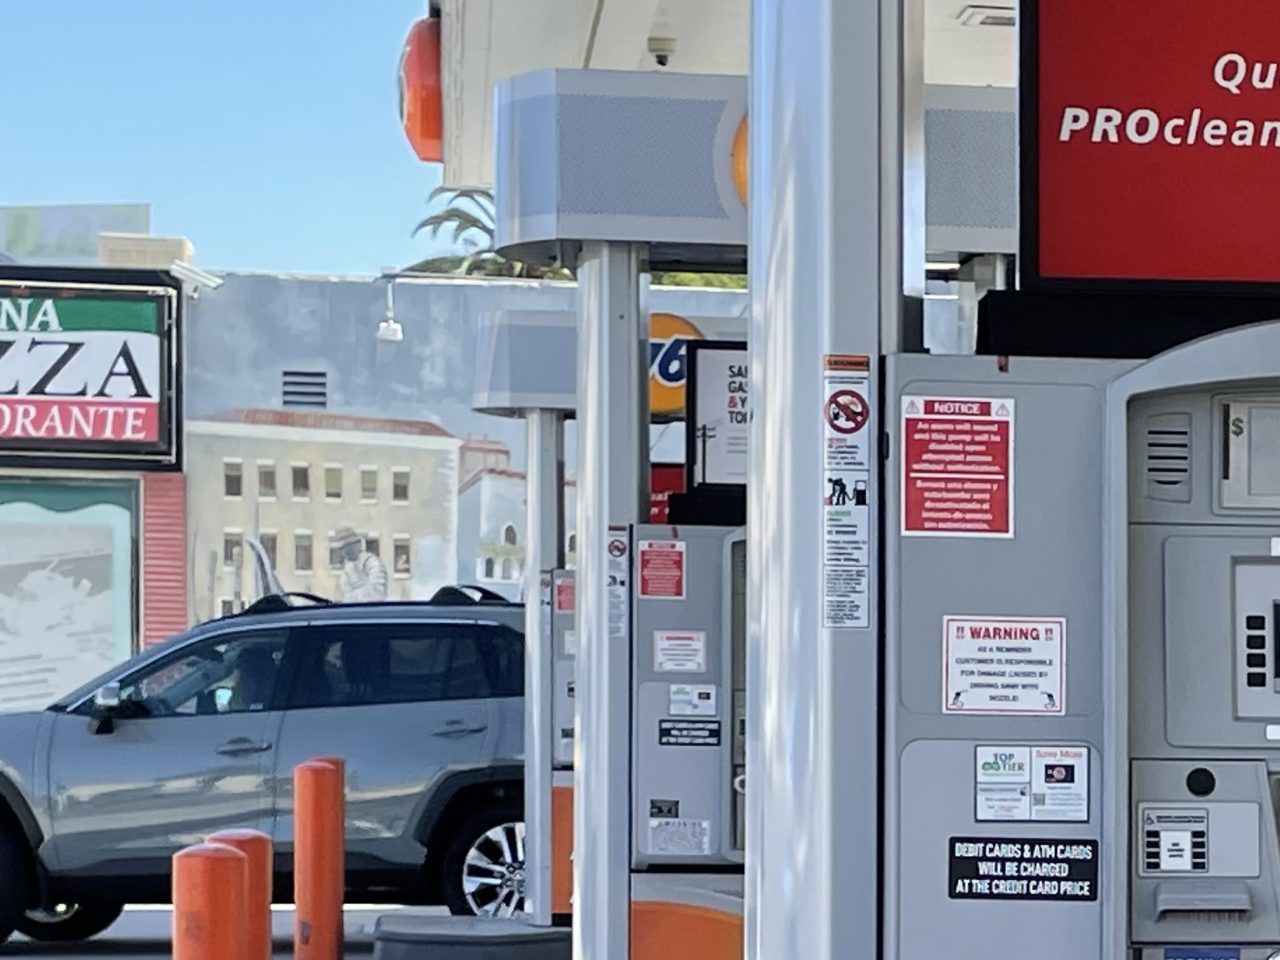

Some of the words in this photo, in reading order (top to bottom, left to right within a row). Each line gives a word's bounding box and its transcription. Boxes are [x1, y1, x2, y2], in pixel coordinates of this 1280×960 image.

[728, 381, 748, 394] GA
[934, 401, 981, 414] NOTICE
[1231, 417, 1245, 437] $
[970, 626, 1040, 640] WARNING
[955, 842, 984, 857] DEBIT
[985, 843, 1022, 858] CARDS
[1023, 844, 1032, 858] &
[1033, 844, 1055, 858] ATM
[1057, 844, 1093, 859] CARDS
[977, 861, 1003, 876] WILL
[1005, 862, 1018, 876] BE
[1020, 862, 1069, 877] CHARGED
[955, 879, 970, 894] AT
[972, 880, 990, 894] THE
[992, 880, 1028, 895] CREDIT
[1029, 880, 1058, 895] CARD
[1060, 881, 1090, 896] PRICE
